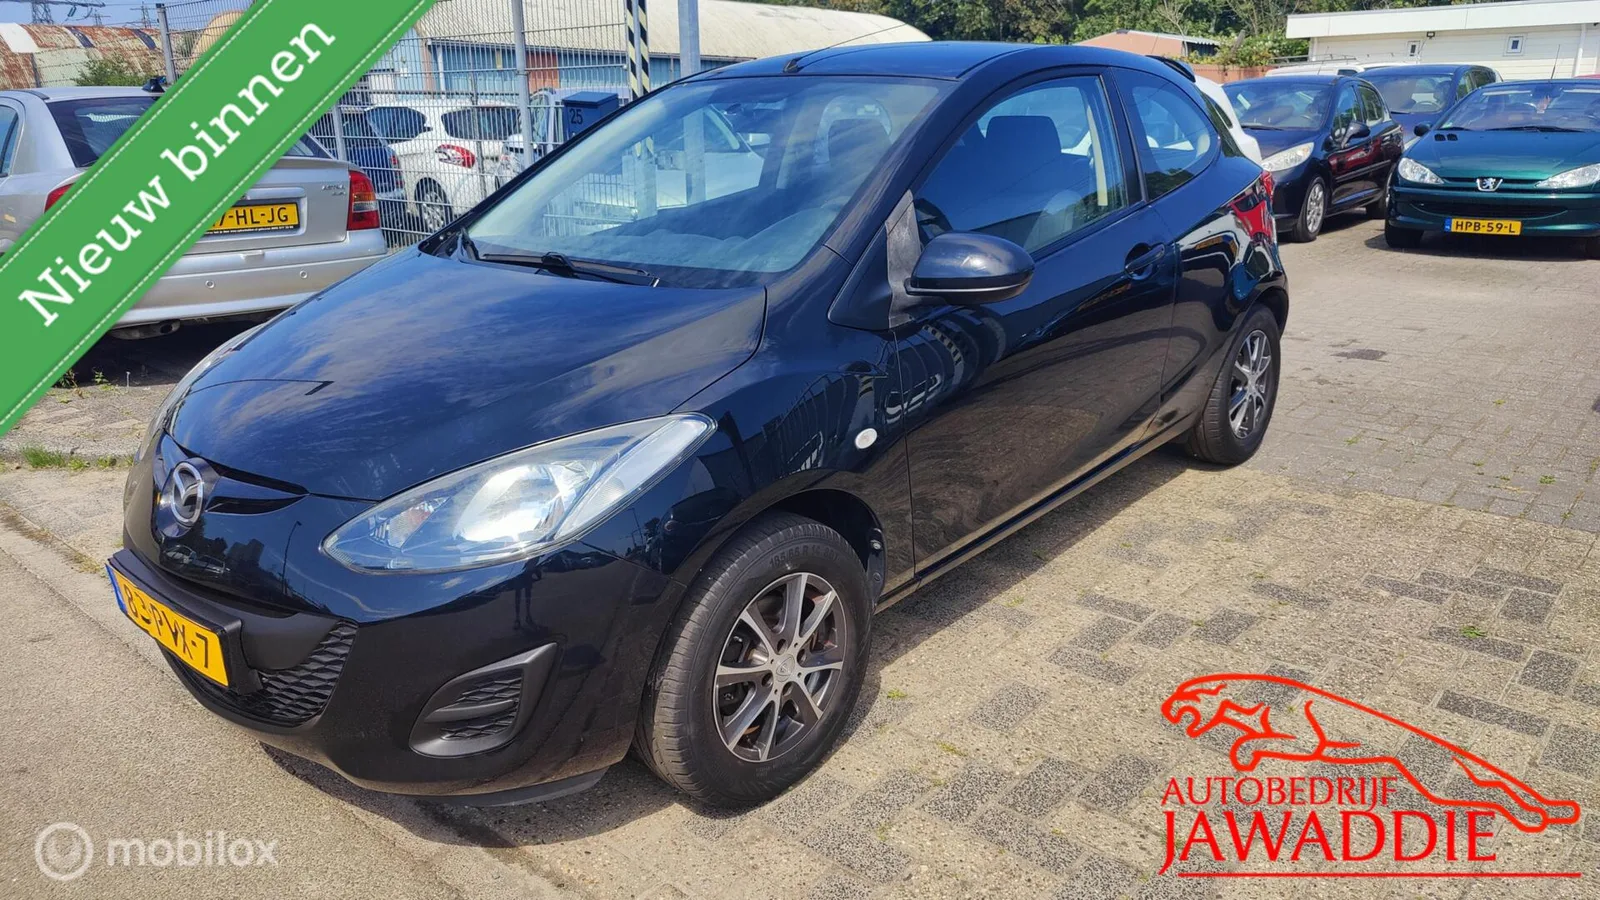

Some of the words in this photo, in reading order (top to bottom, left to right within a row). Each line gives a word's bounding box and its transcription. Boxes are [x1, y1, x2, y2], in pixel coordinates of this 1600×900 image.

[569, 108, 583, 125] 25
[212, 206, 290, 228] 7-HL-JG
[1455, 221, 1516, 234] HPB-59-L
